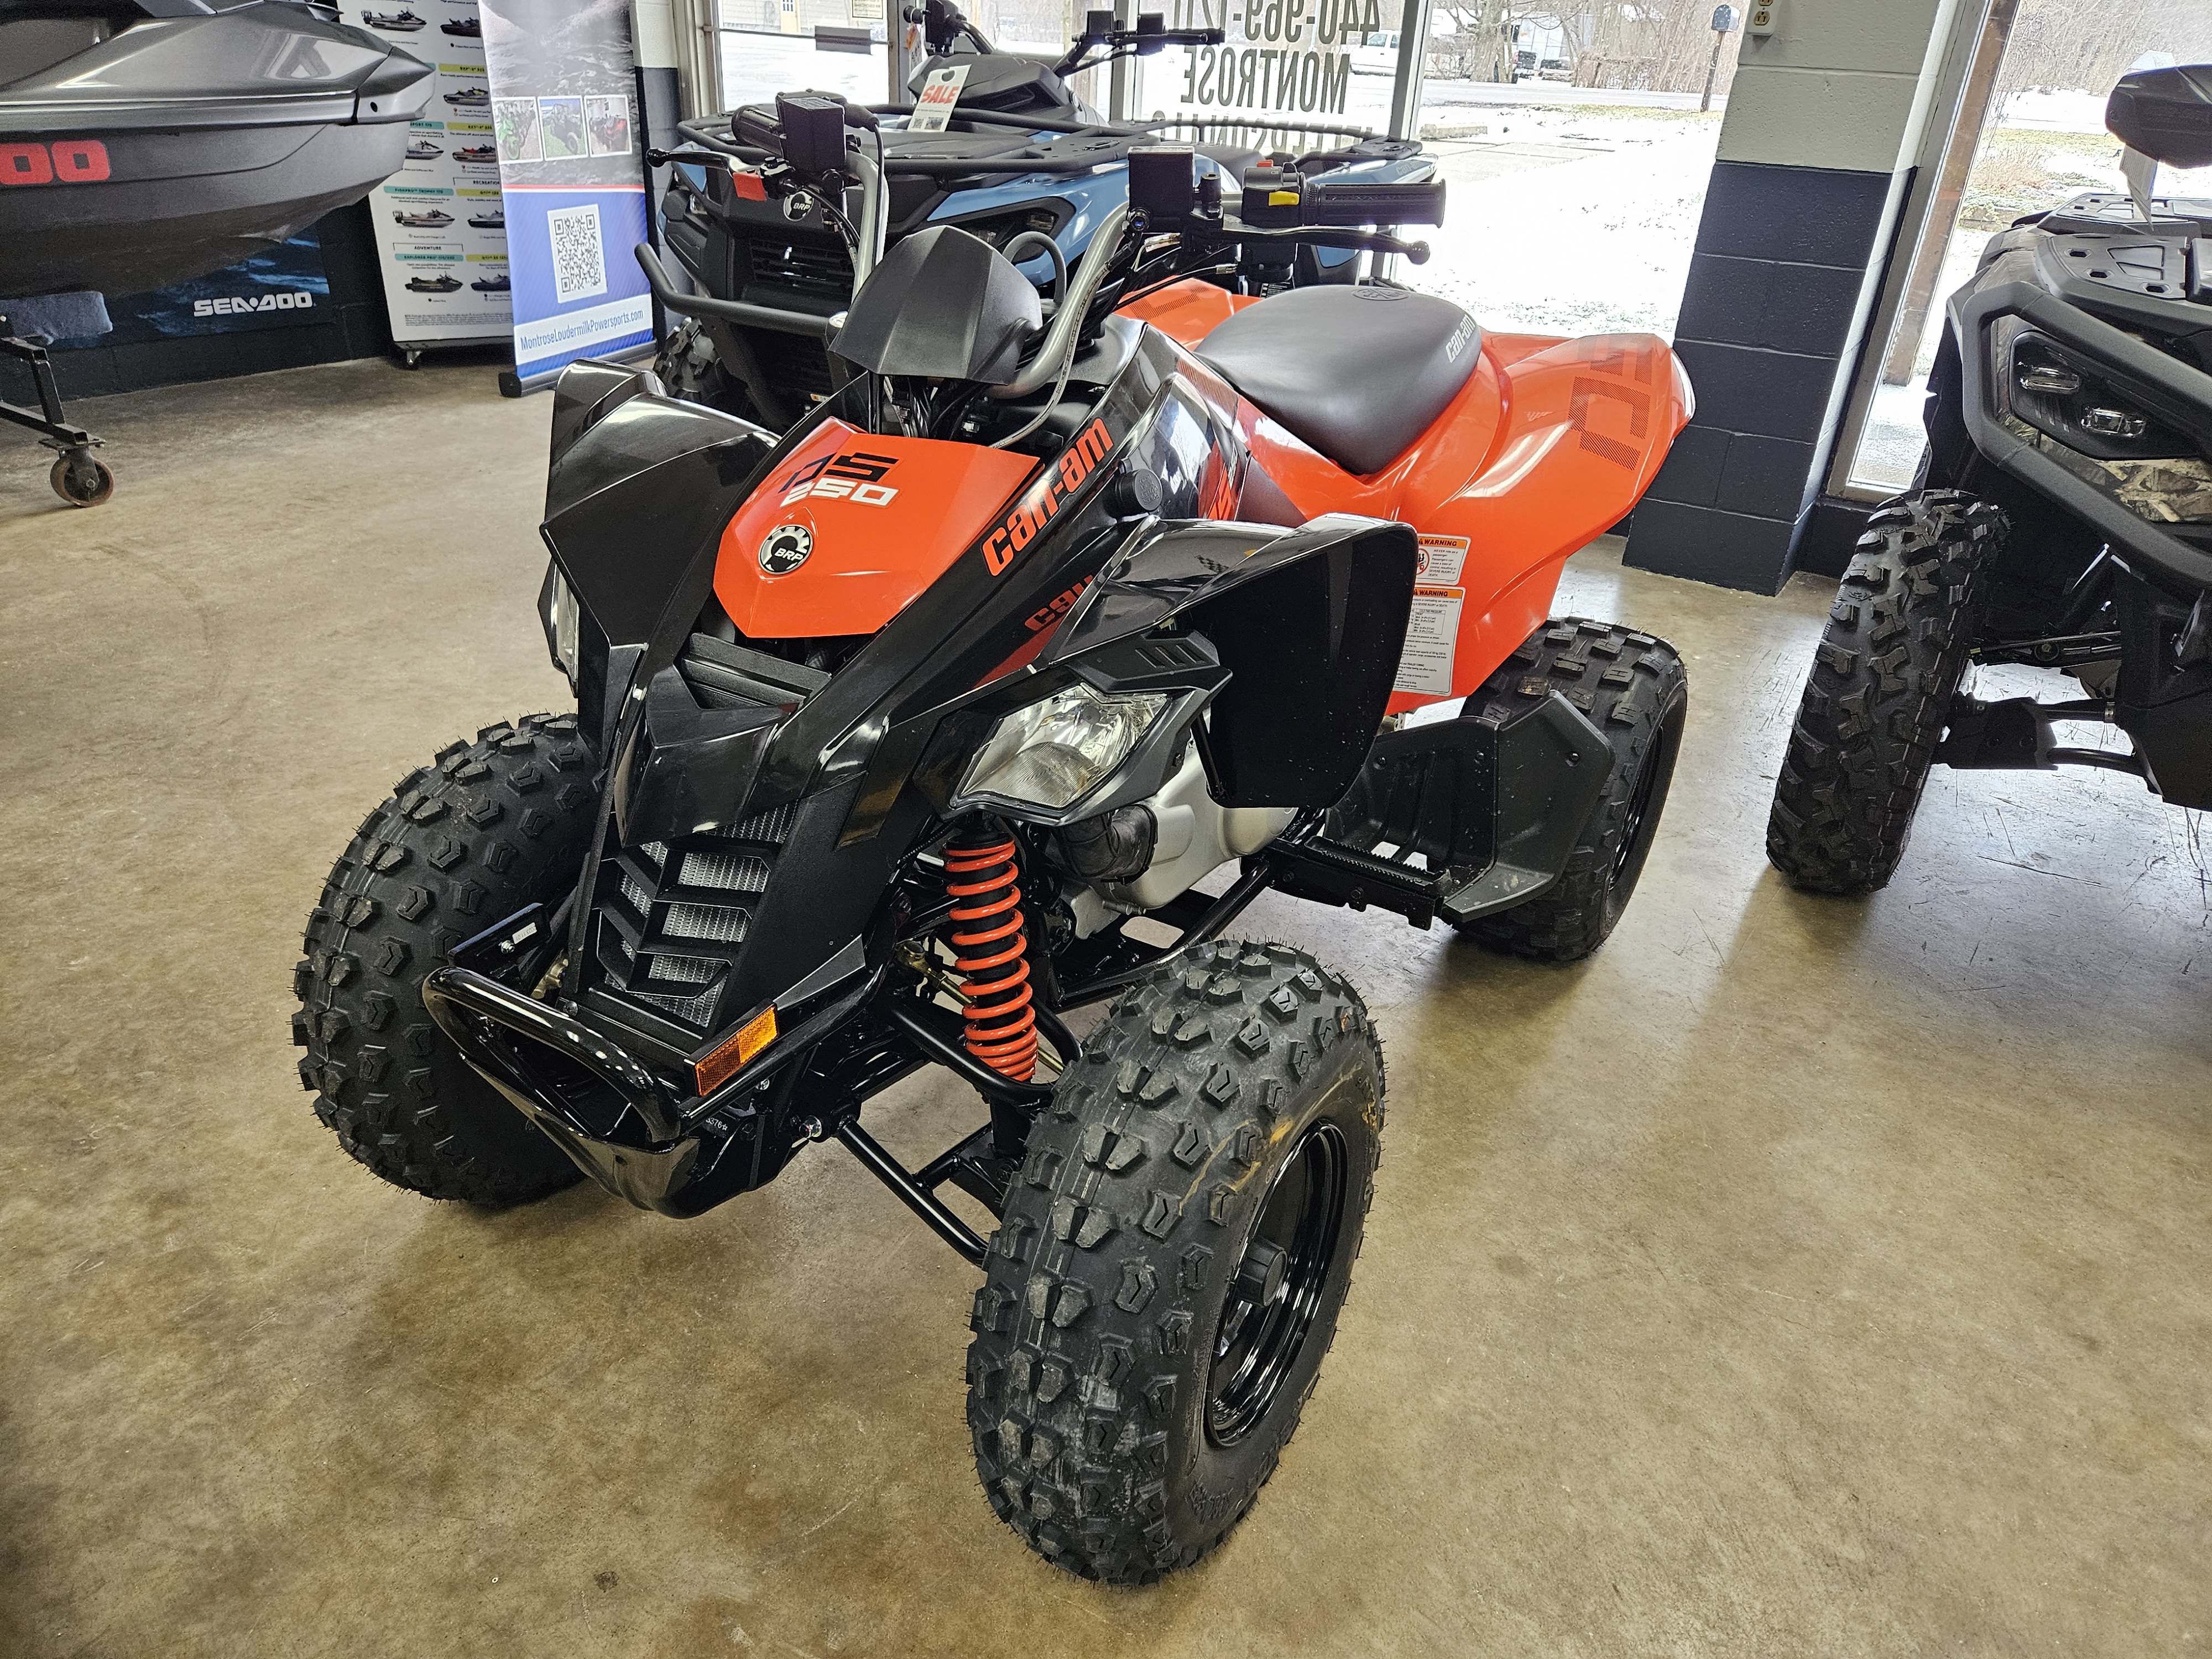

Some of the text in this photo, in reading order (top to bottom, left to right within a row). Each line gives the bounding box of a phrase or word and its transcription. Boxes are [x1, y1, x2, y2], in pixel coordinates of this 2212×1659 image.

[920, 85, 961, 104] SALE
[793, 202, 811, 211] BRP
[520, 310, 644, 351] MontroseLoudermilkPowersports.com
[1446, 314, 1476, 363] can-am
[779, 477, 900, 508] 250
[982, 418, 1114, 576] can-am
[774, 547, 804, 561] BRP
